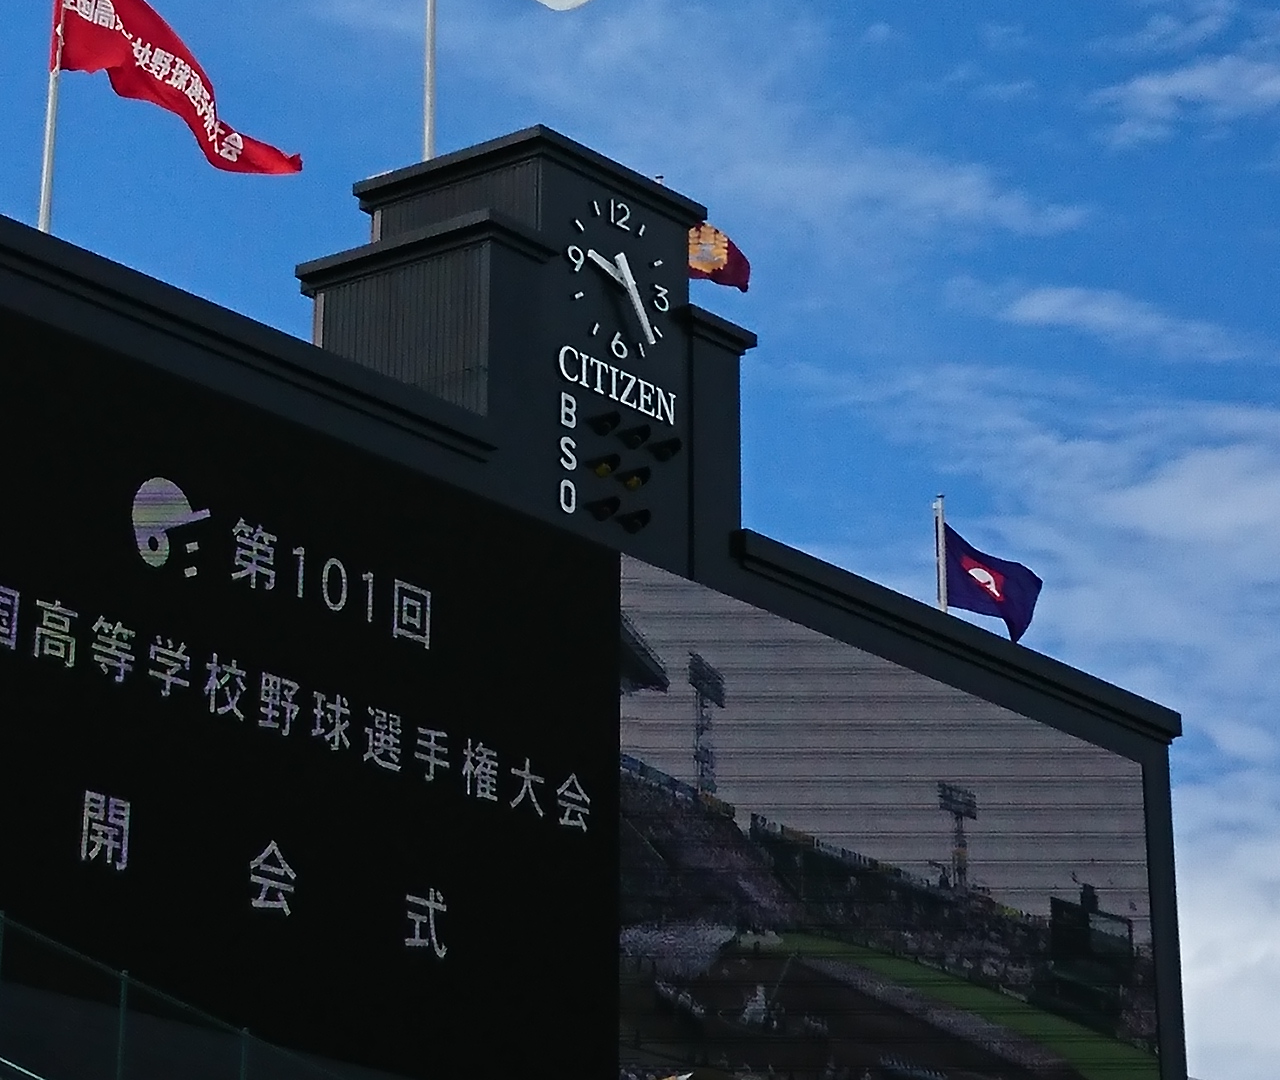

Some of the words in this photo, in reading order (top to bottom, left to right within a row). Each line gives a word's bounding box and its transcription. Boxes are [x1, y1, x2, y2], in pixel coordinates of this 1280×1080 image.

[610, 198, 631, 231] 12
[567, 245, 585, 272] 9
[653, 284, 670, 312] 3
[610, 331, 628, 359] 6
[558, 345, 677, 426] CITIZEN
[230, 516, 432, 650] 第101回
